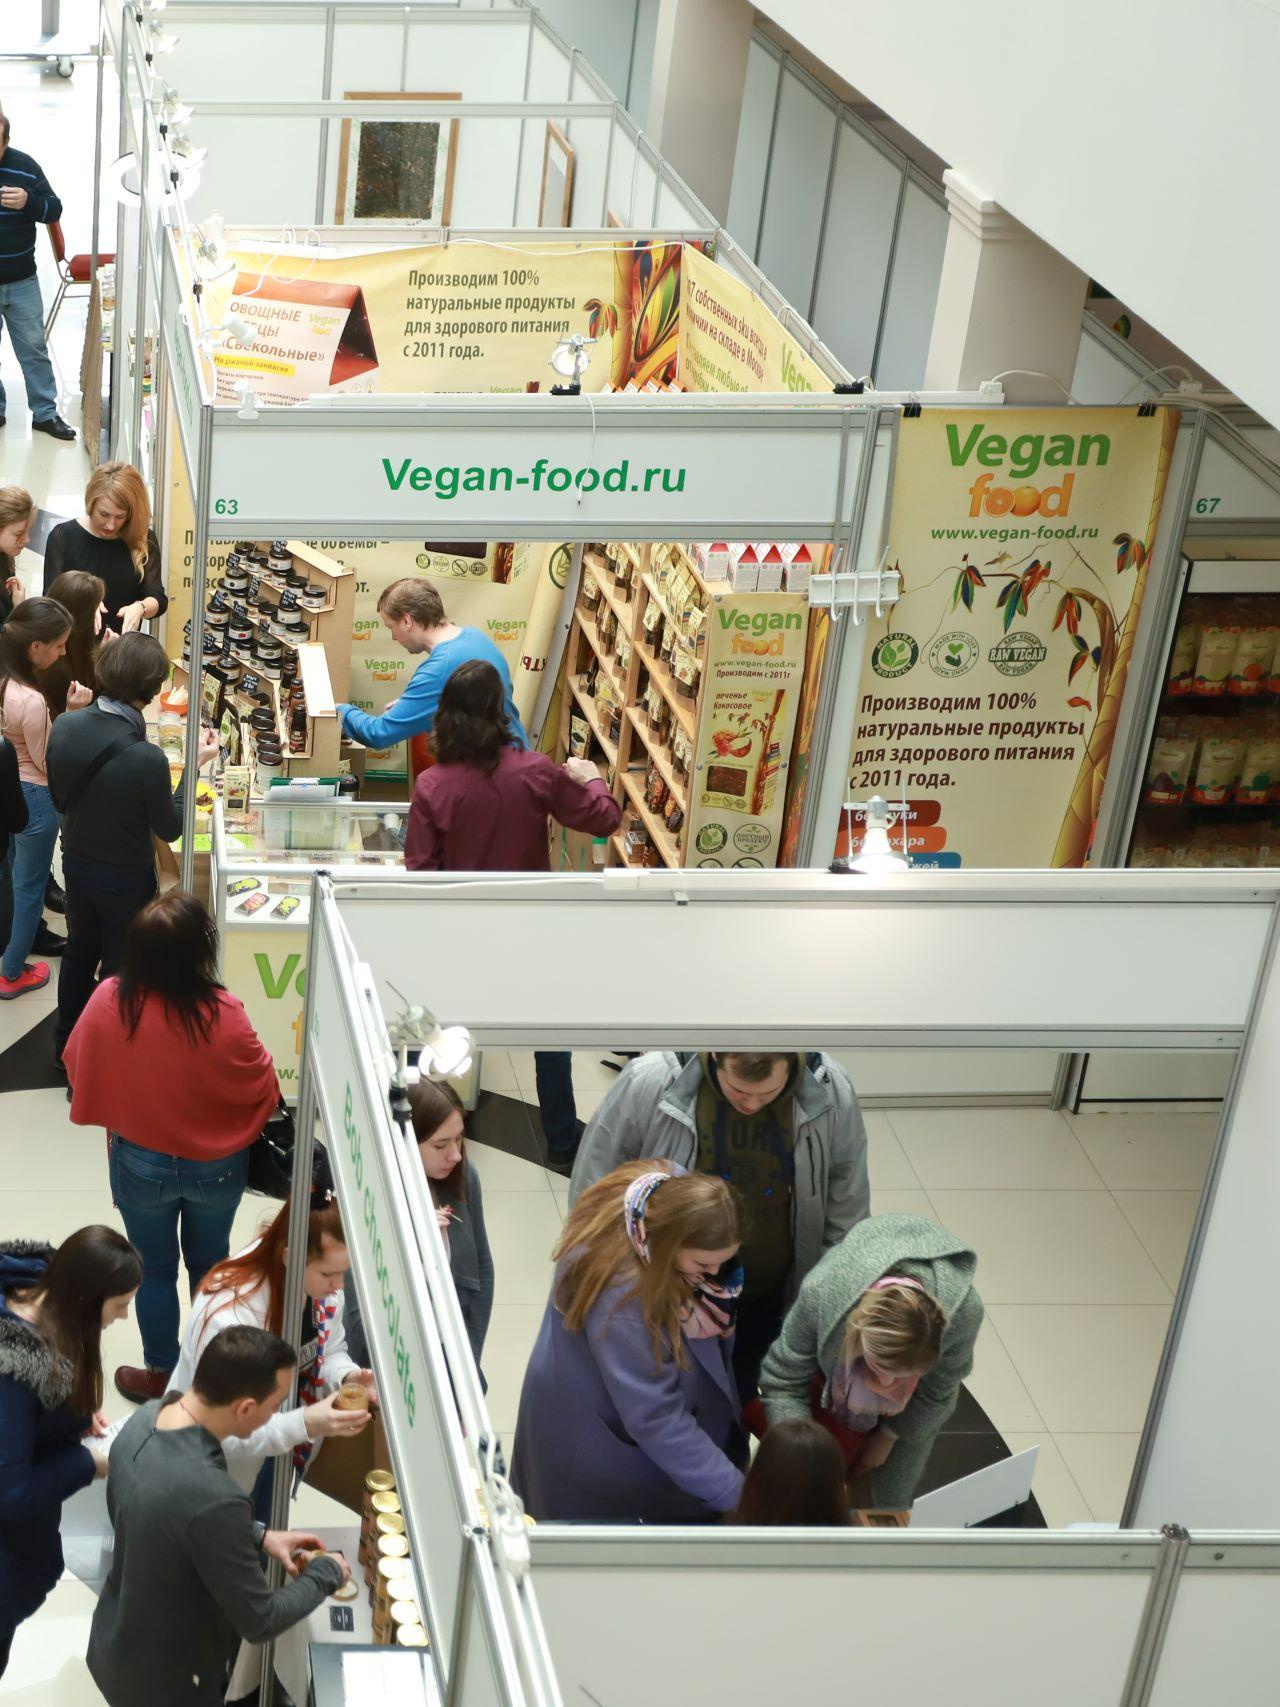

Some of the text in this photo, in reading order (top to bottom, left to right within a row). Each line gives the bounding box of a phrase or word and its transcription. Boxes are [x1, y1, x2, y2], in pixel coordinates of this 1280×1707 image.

[409, 270, 540, 290] Производим 100%
[230, 302, 302, 323] ОВОЩНЫЕ
[406, 297, 575, 314] натуральные продукты
[695, 288, 737, 331] собственных
[404, 320, 570, 338] для здорового питания
[412, 341, 445, 357] 2011
[449, 344, 484, 360] года.
[718, 331, 740, 360] складе
[945, 424, 1111, 478] Vegan
[382, 458, 686, 500] Vegan-food.ru
[968, 473, 1075, 518] food
[214, 498, 239, 515] 63
[1196, 498, 1221, 513] 67
[931, 524, 1099, 543] www.vegan-food.ru
[486, 619, 527, 632] Vegan
[718, 609, 803, 637] Vegan
[732, 632, 785, 656] food
[876, 633, 916, 650] NATURAL
[714, 658, 797, 669] www.vegan-food.ru
[989, 647, 1046, 662] RAW VEGAN
[364, 659, 405, 672] Vegan
[716, 669, 763, 679] Производим
[715, 691, 748, 700] печенье
[861, 692, 1037, 715] Производим 100%
[857, 720, 1084, 740] натуральные продукты
[852, 746, 1075, 768] для здорового питания
[859, 770, 902, 788] 2011
[907, 772, 956, 789] года.
[364, 1187, 417, 1428] chocolate
